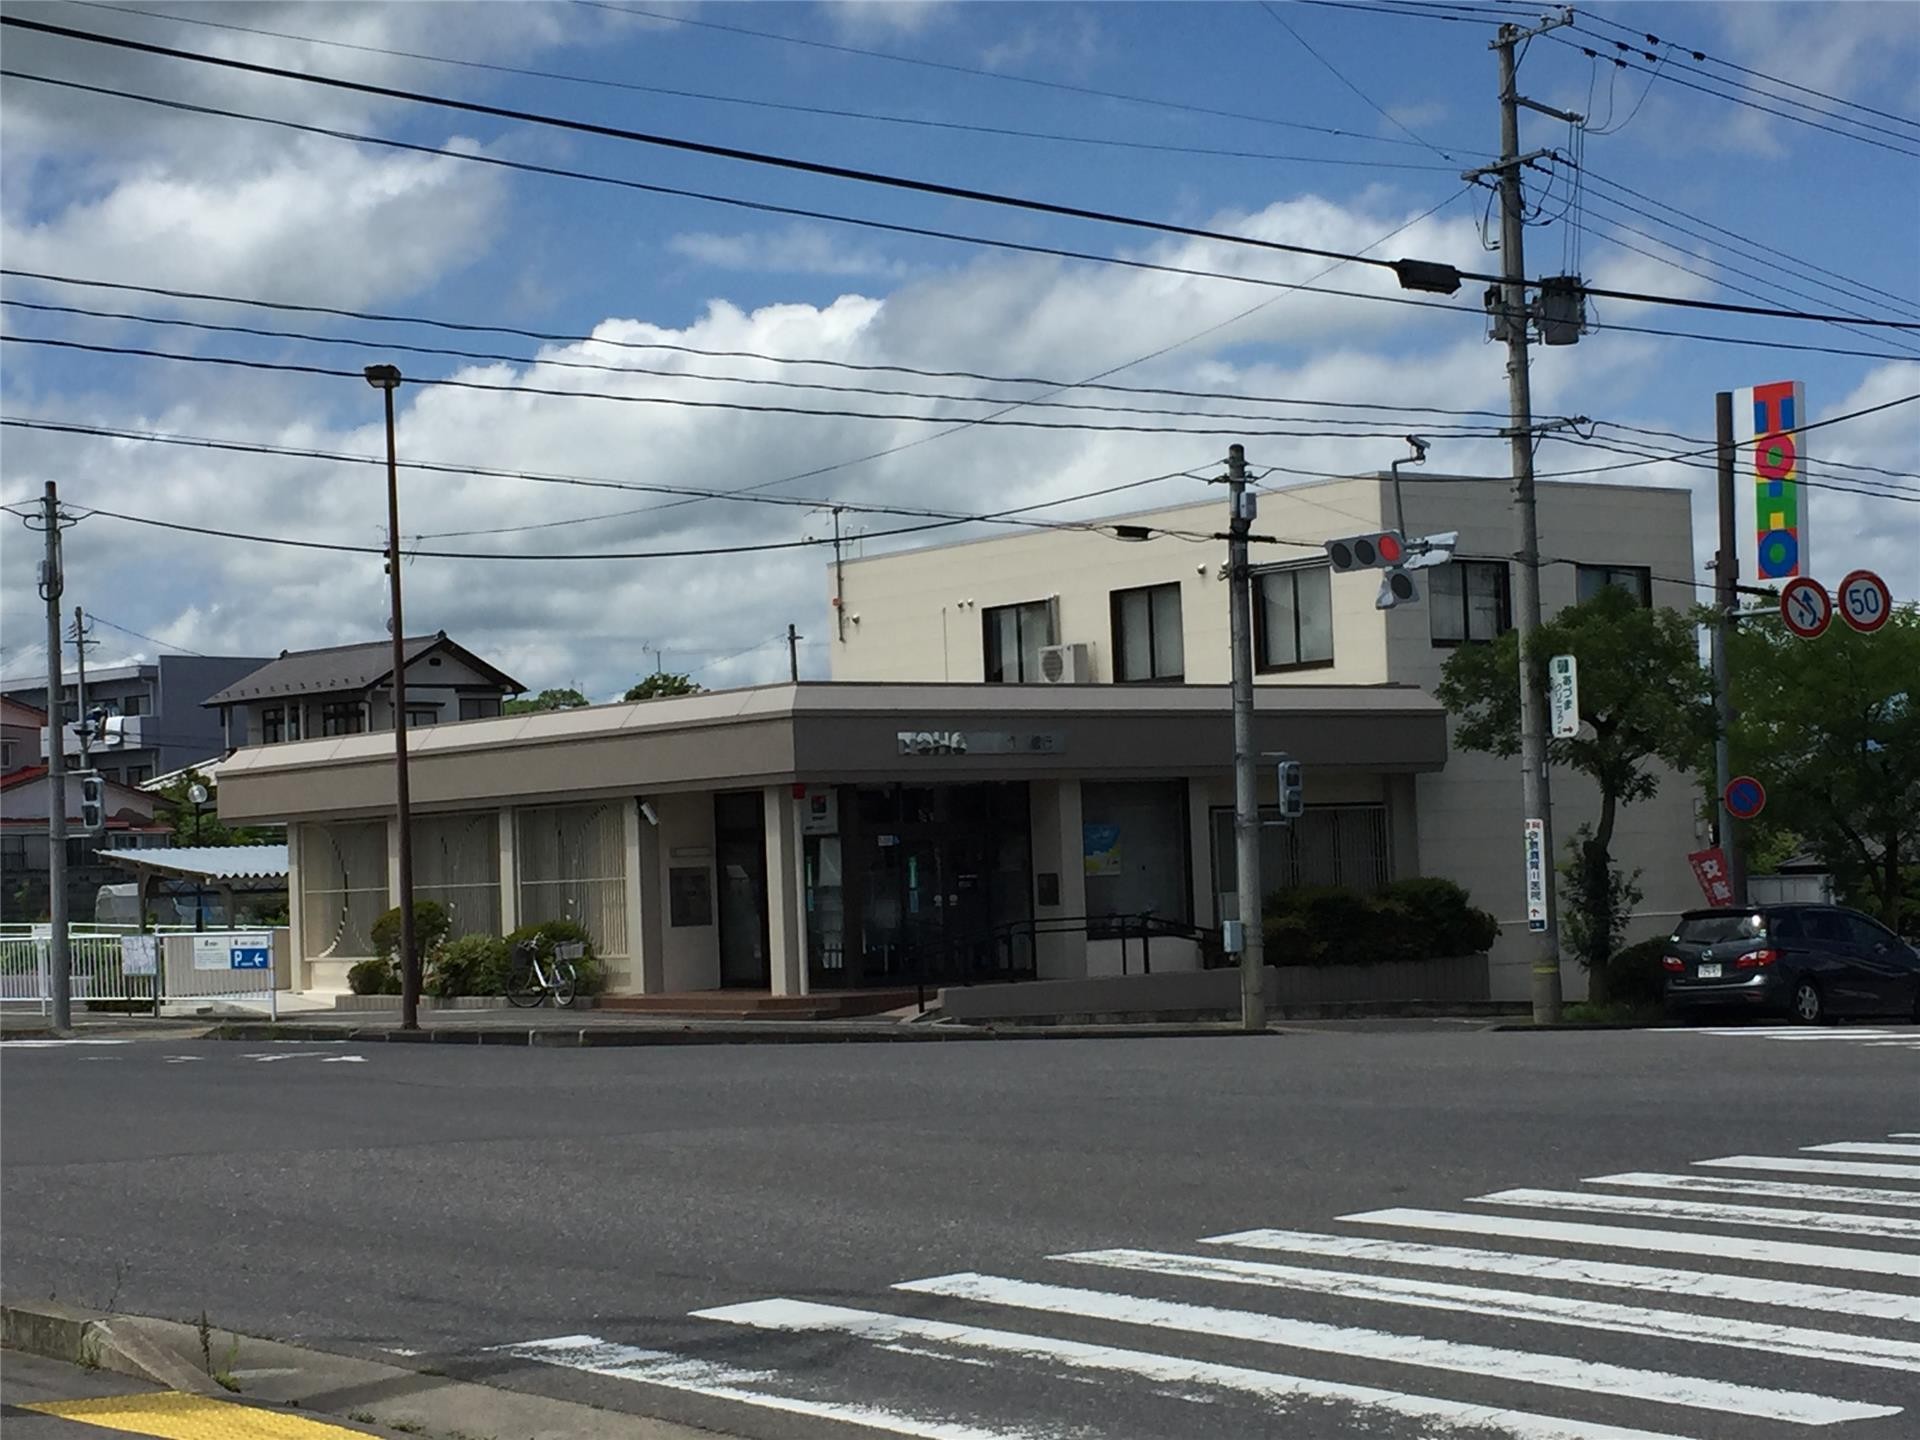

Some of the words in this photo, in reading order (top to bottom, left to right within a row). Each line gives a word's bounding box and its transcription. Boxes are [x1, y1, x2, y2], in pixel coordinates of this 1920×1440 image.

[1753, 381, 1799, 580] TOHO
[1848, 586, 1879, 615] 50
[234, 950, 242, 967] P
